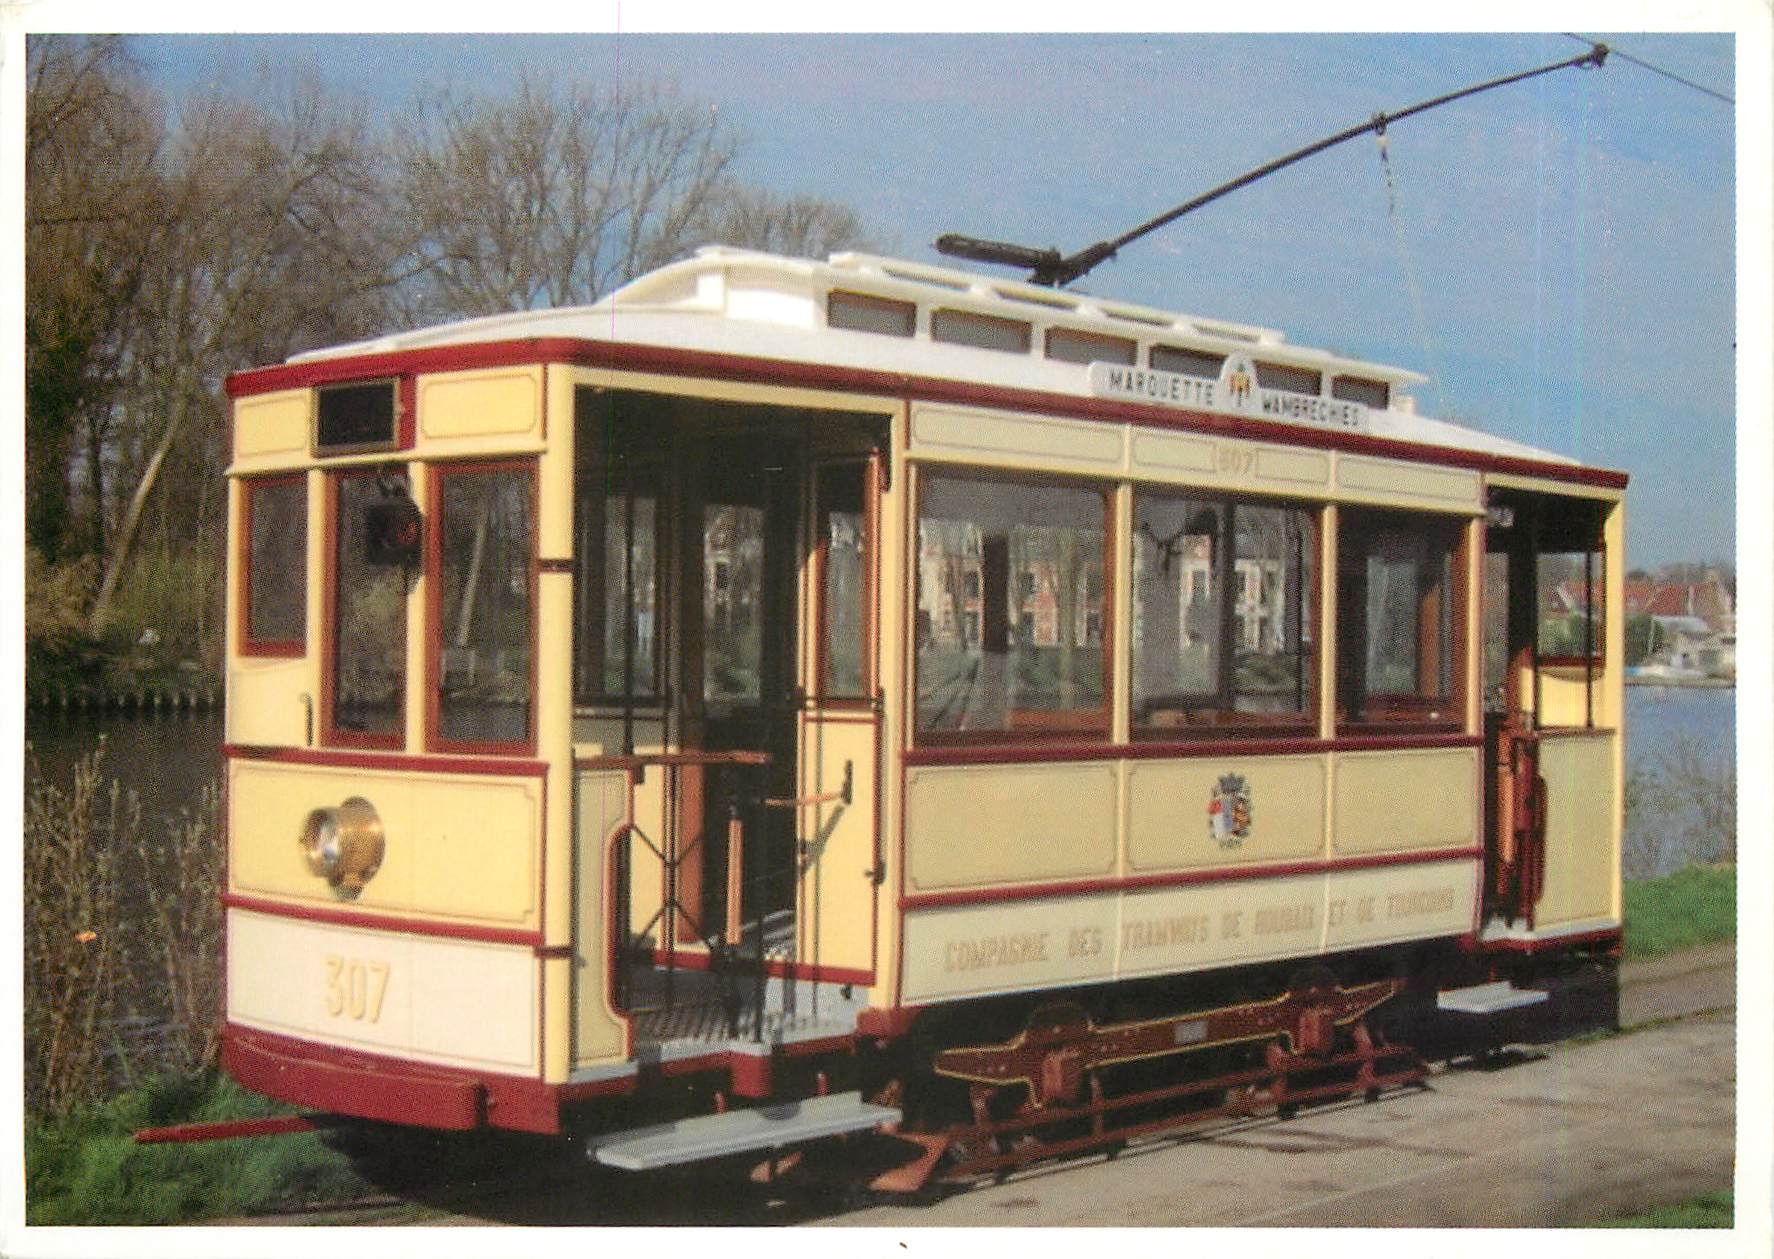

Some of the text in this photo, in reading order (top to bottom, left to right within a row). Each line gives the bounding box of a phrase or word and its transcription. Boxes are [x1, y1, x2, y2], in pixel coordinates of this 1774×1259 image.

[1109, 368, 1360, 426] MARQUETTE WAMBRECHIES
[944, 931, 1049, 973] COMPAGNIE
[1069, 927, 1103, 957] DES
[1222, 910, 1243, 939] DE
[1328, 900, 1347, 926] ET
[325, 955, 391, 1024] 307
